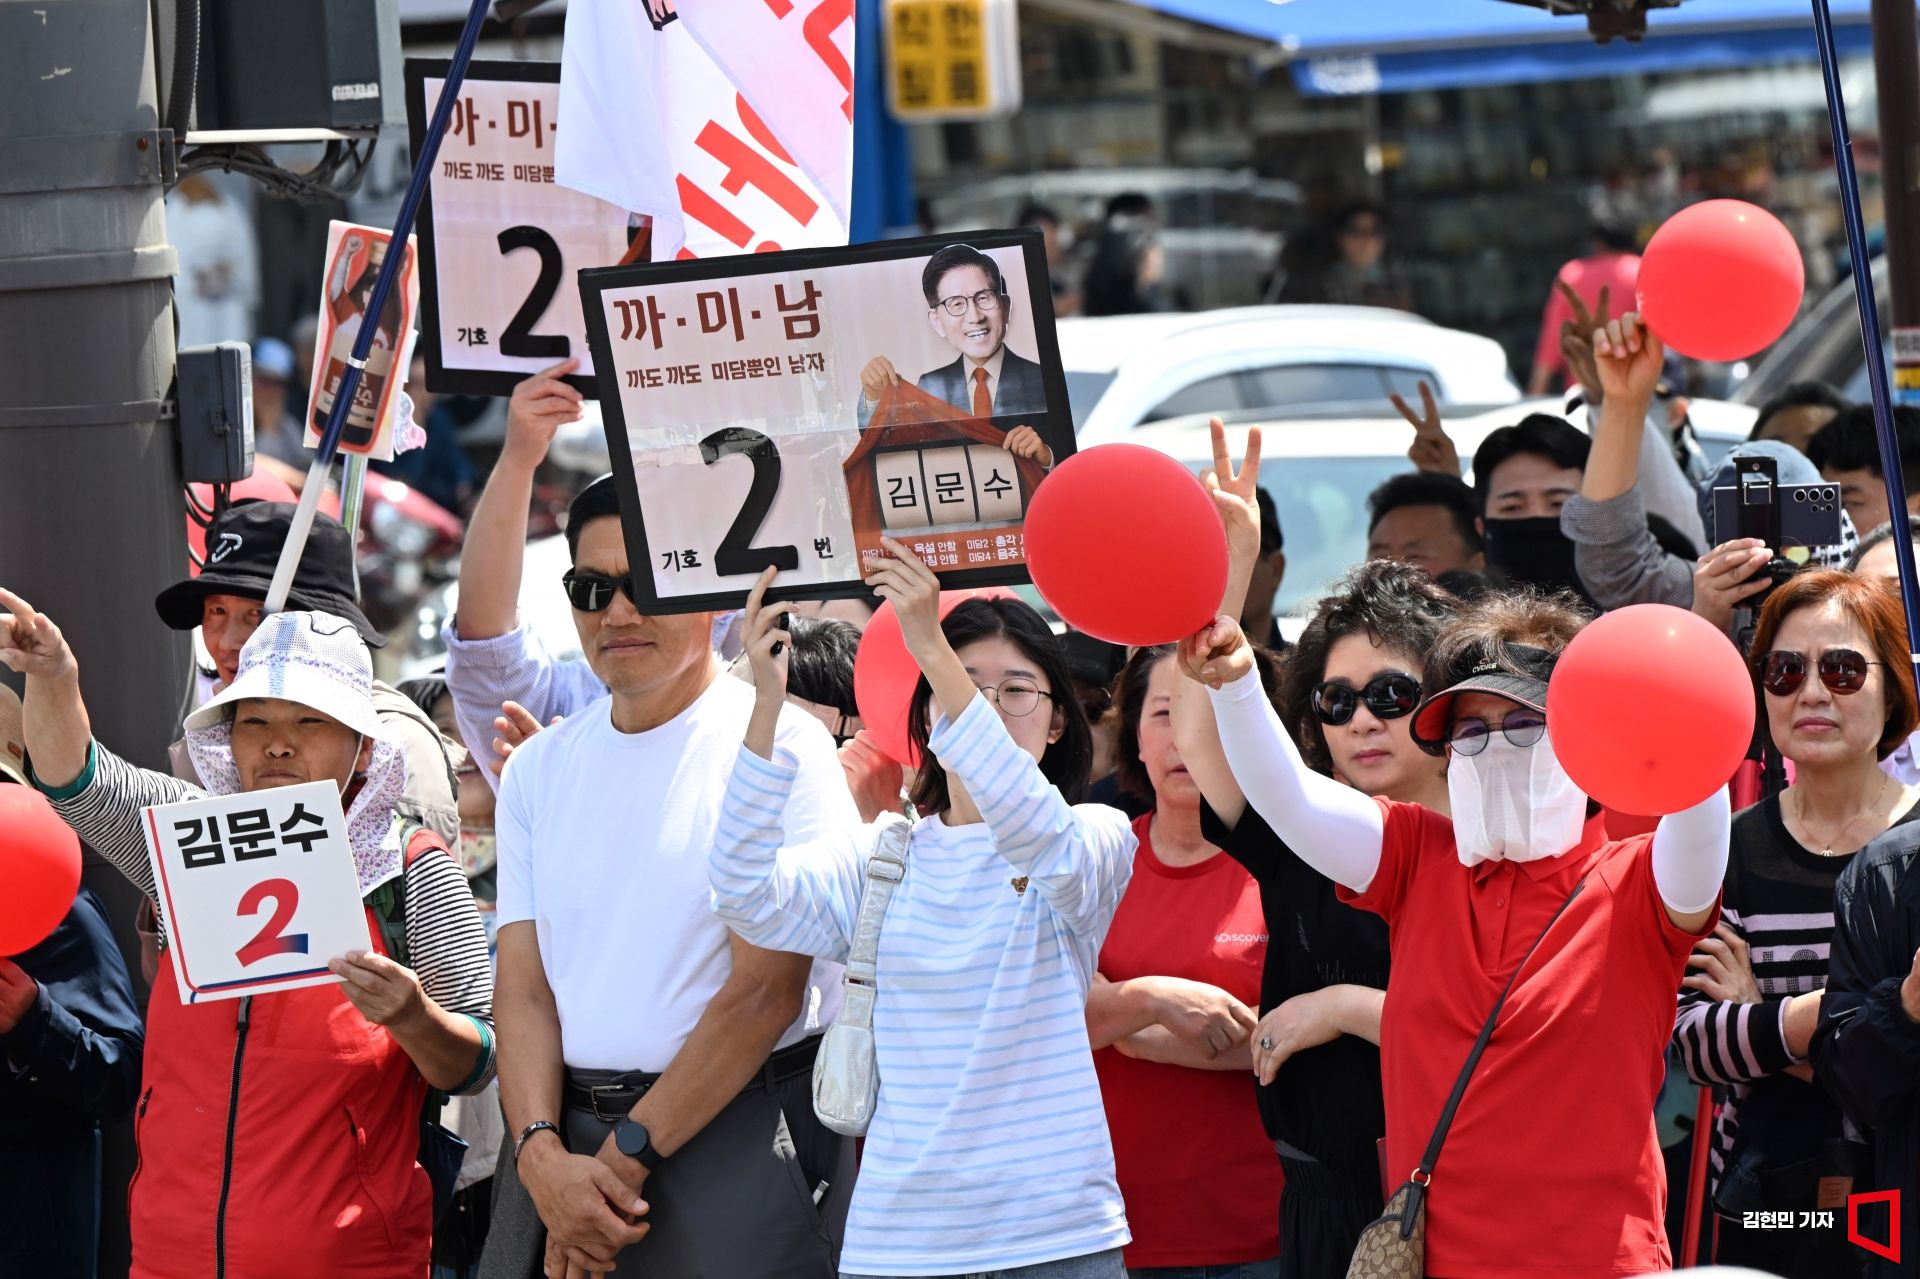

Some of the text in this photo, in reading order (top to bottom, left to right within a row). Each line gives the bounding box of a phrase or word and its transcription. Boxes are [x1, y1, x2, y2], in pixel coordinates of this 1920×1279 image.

[443, 161, 473, 180] 까도
[476, 163, 505, 181] 까도
[457, 225, 570, 358] 기호 2
[626, 352, 825, 389] 까도 까도 미담뿐인 남자
[662, 427, 834, 577] 기호 2 번
[914, 541, 936, 554] 욕설
[938, 540, 957, 552] 안함
[940, 553, 959, 566] 안함
[173, 803, 329, 869] 김문수
[235, 878, 308, 967] 2
